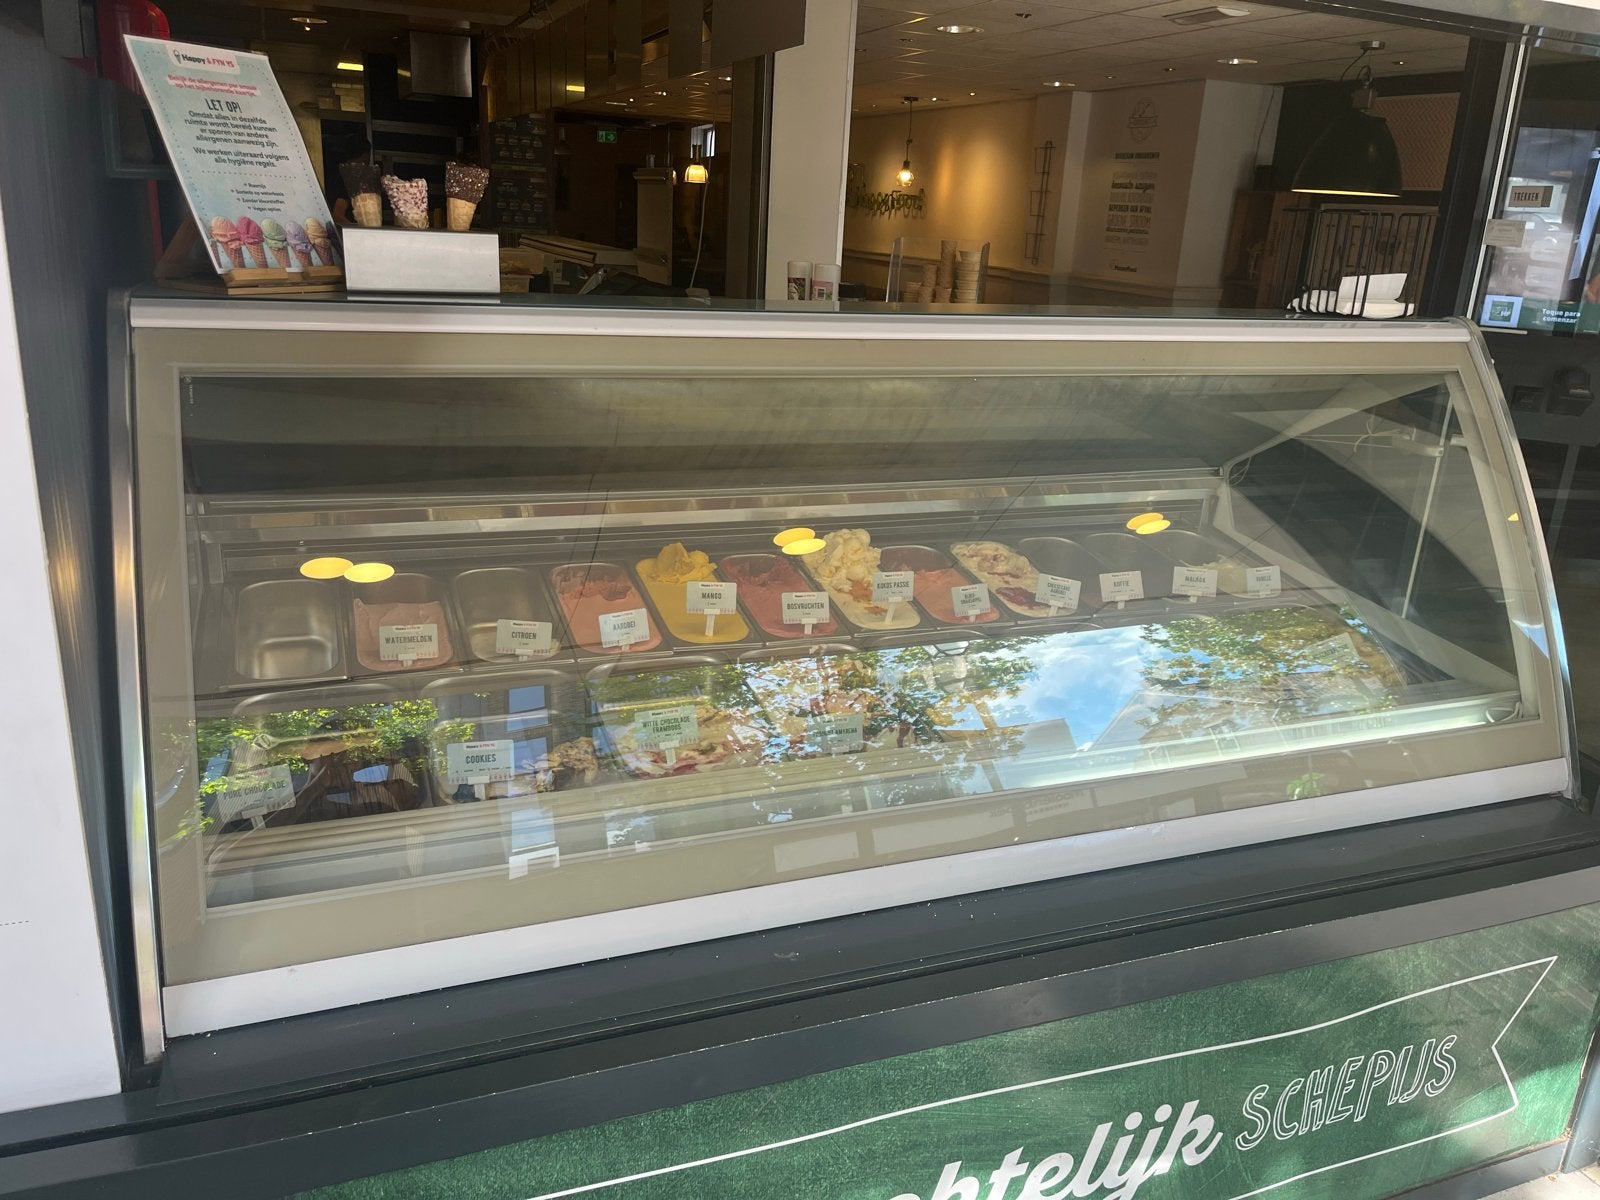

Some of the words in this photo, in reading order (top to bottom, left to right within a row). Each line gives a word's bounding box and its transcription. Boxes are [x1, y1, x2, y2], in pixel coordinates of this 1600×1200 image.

[181, 54, 206, 65] Happy
[205, 98, 224, 112] LET
[225, 100, 243, 114] OP!
[188, 110, 214, 120] Omdat
[215, 113, 230, 121] alles
[239, 116, 267, 125] dezelfde
[184, 118, 209, 126] ruimte
[209, 120, 230, 128] wordt
[230, 121, 252, 130] bereid
[253, 125, 278, 133] kunnen
[208, 128, 233, 136] sporen
[246, 131, 269, 140] andere
[196, 134, 233, 144] allergenen
[233, 138, 265, 148] aanwezig
[192, 146, 206, 155] We
[206, 148, 233, 156] werken
[233, 149, 264, 159] uiteraard
[264, 153, 290, 162] volgens
[214, 156, 227, 164] alle
[1542, 308, 1564, 317] Toque
[1564, 310, 1581, 318] para
[1542, 316, 1579, 324] comenzar
[701, 592, 722, 600] MANGO
[786, 602, 825, 610] BOSVRUCHTEN
[384, 635, 433, 645] WATERMELOEN
[511, 631, 537, 640] CITROEN
[465, 753, 497, 765] COOKIES
[888, 1099, 1223, 1200] htelijk
[1234, 1032, 1459, 1152] SCHEPIJS
